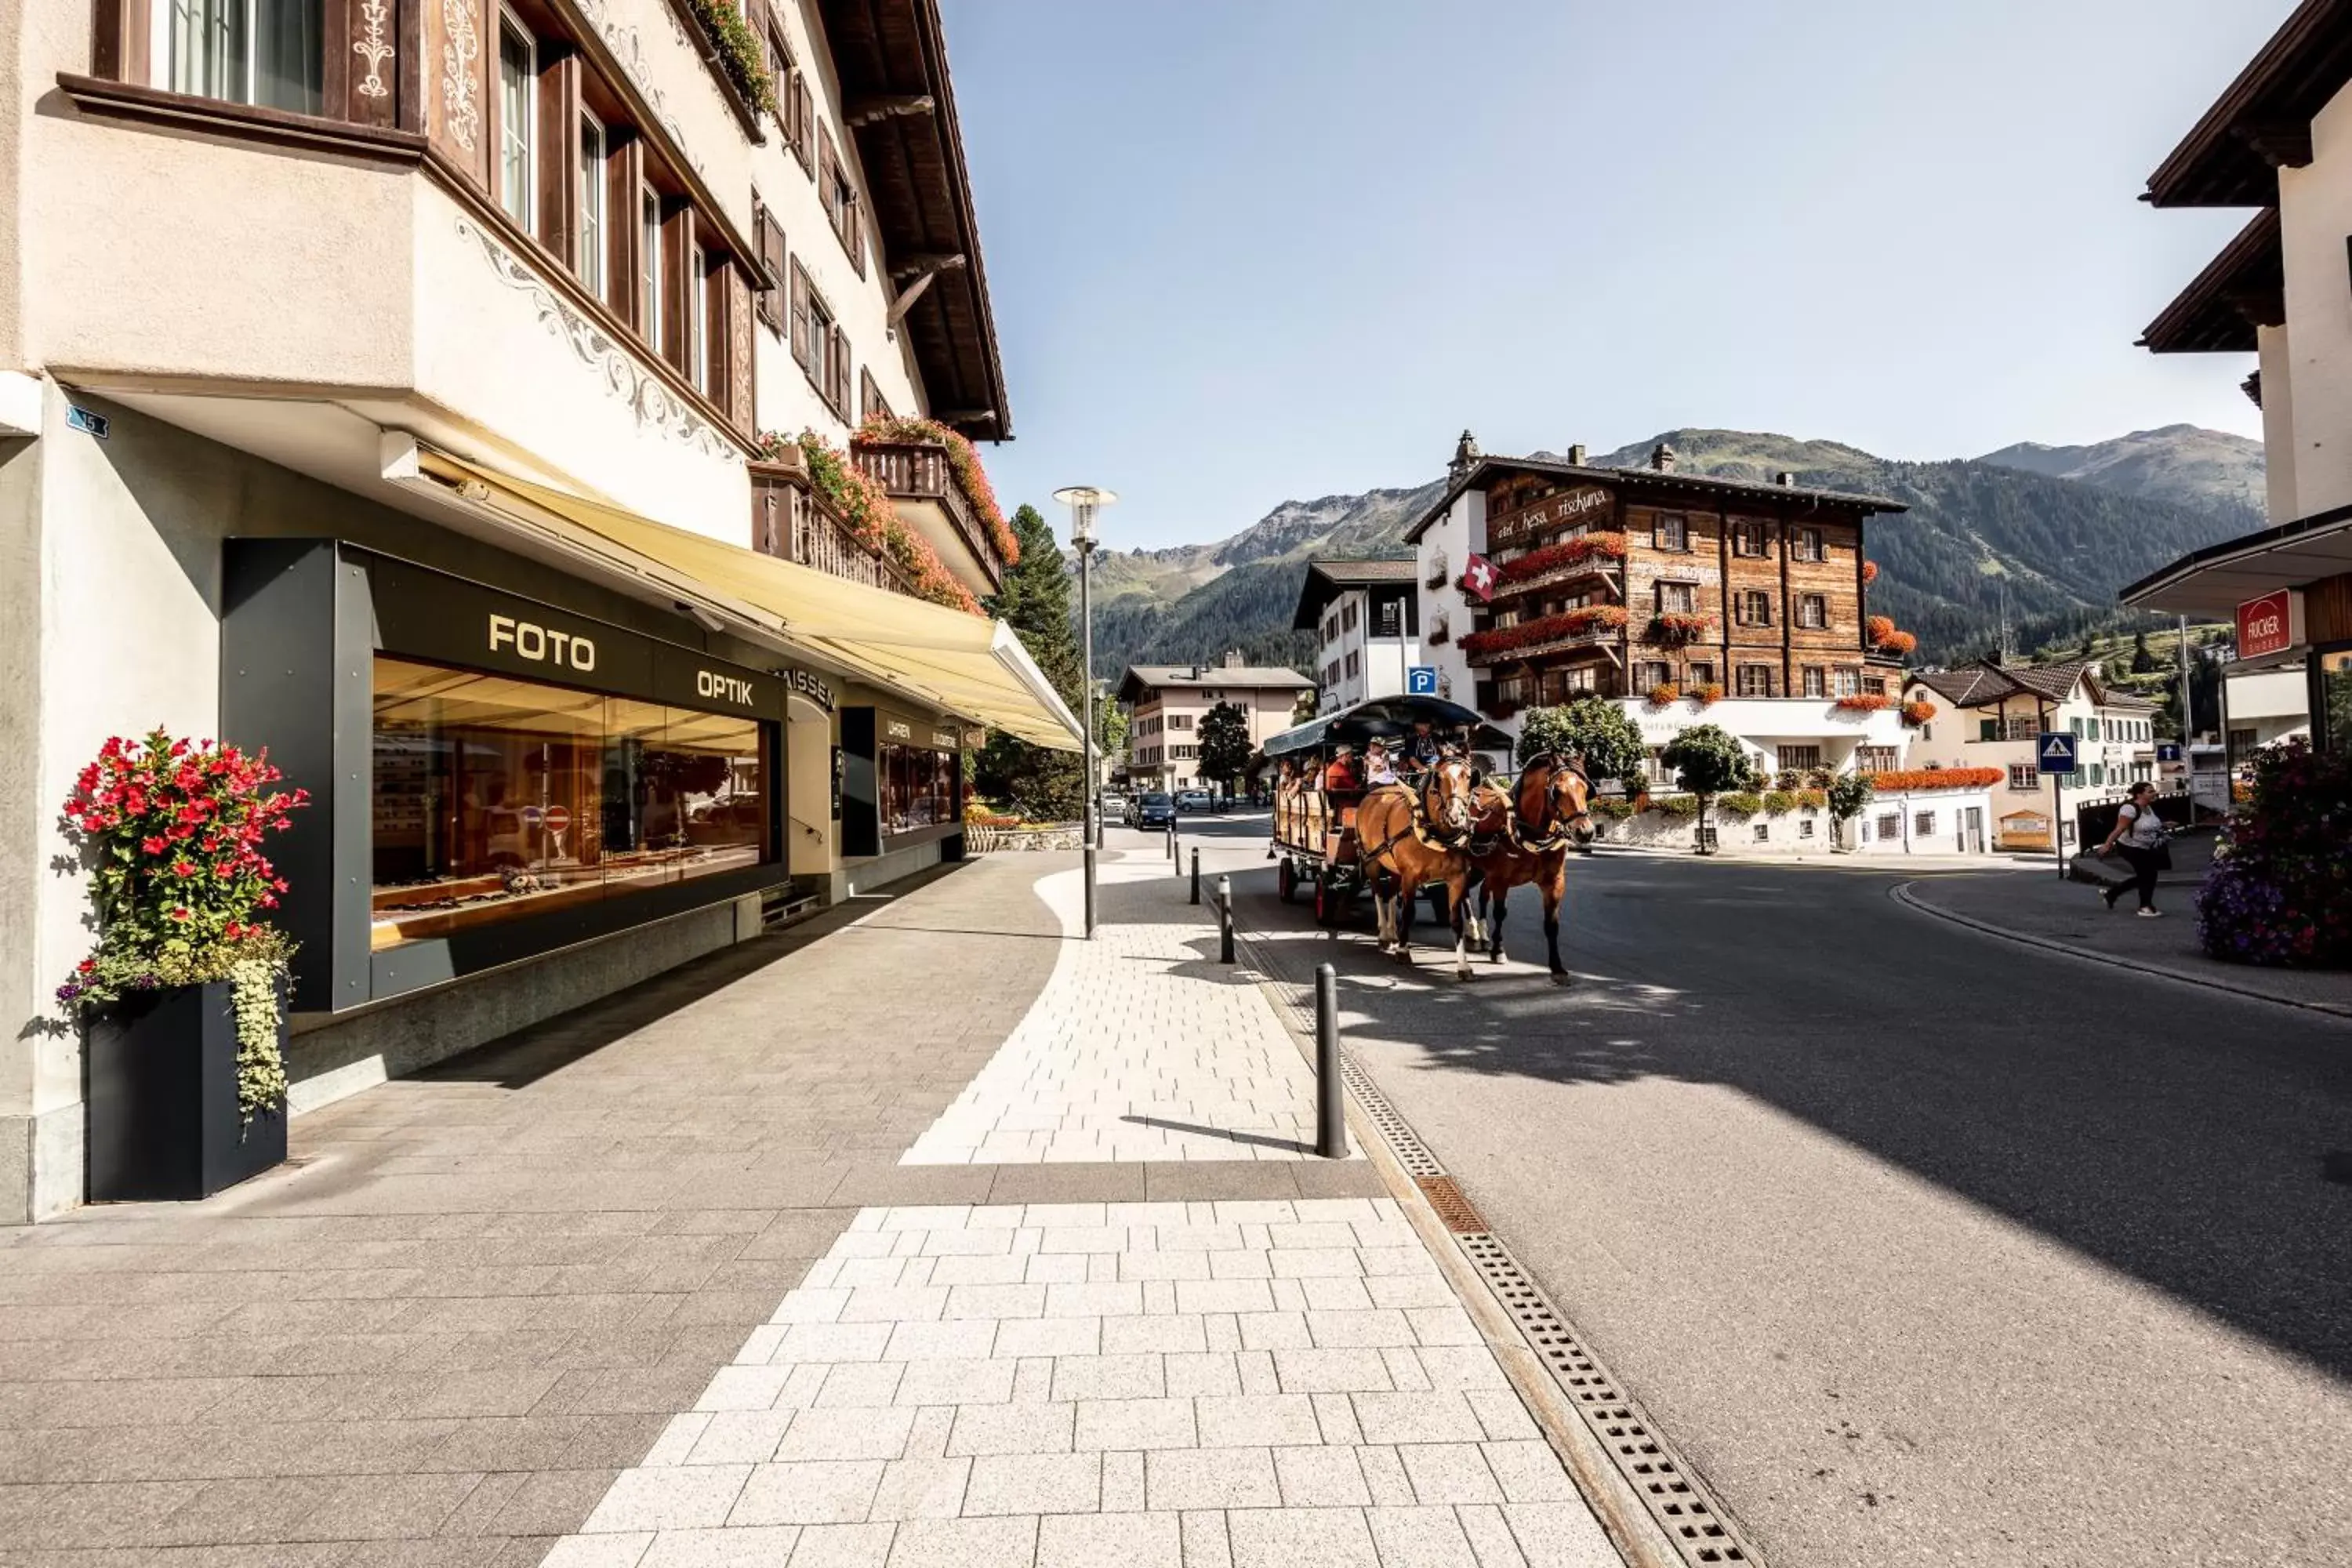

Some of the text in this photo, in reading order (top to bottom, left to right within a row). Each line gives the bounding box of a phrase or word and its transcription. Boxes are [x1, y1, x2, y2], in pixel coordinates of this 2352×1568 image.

[489, 614, 595, 672] FOTO
[697, 670, 753, 706] OPTIK
[771, 668, 837, 711] AISSEN
[1417, 675, 1428, 691] P
